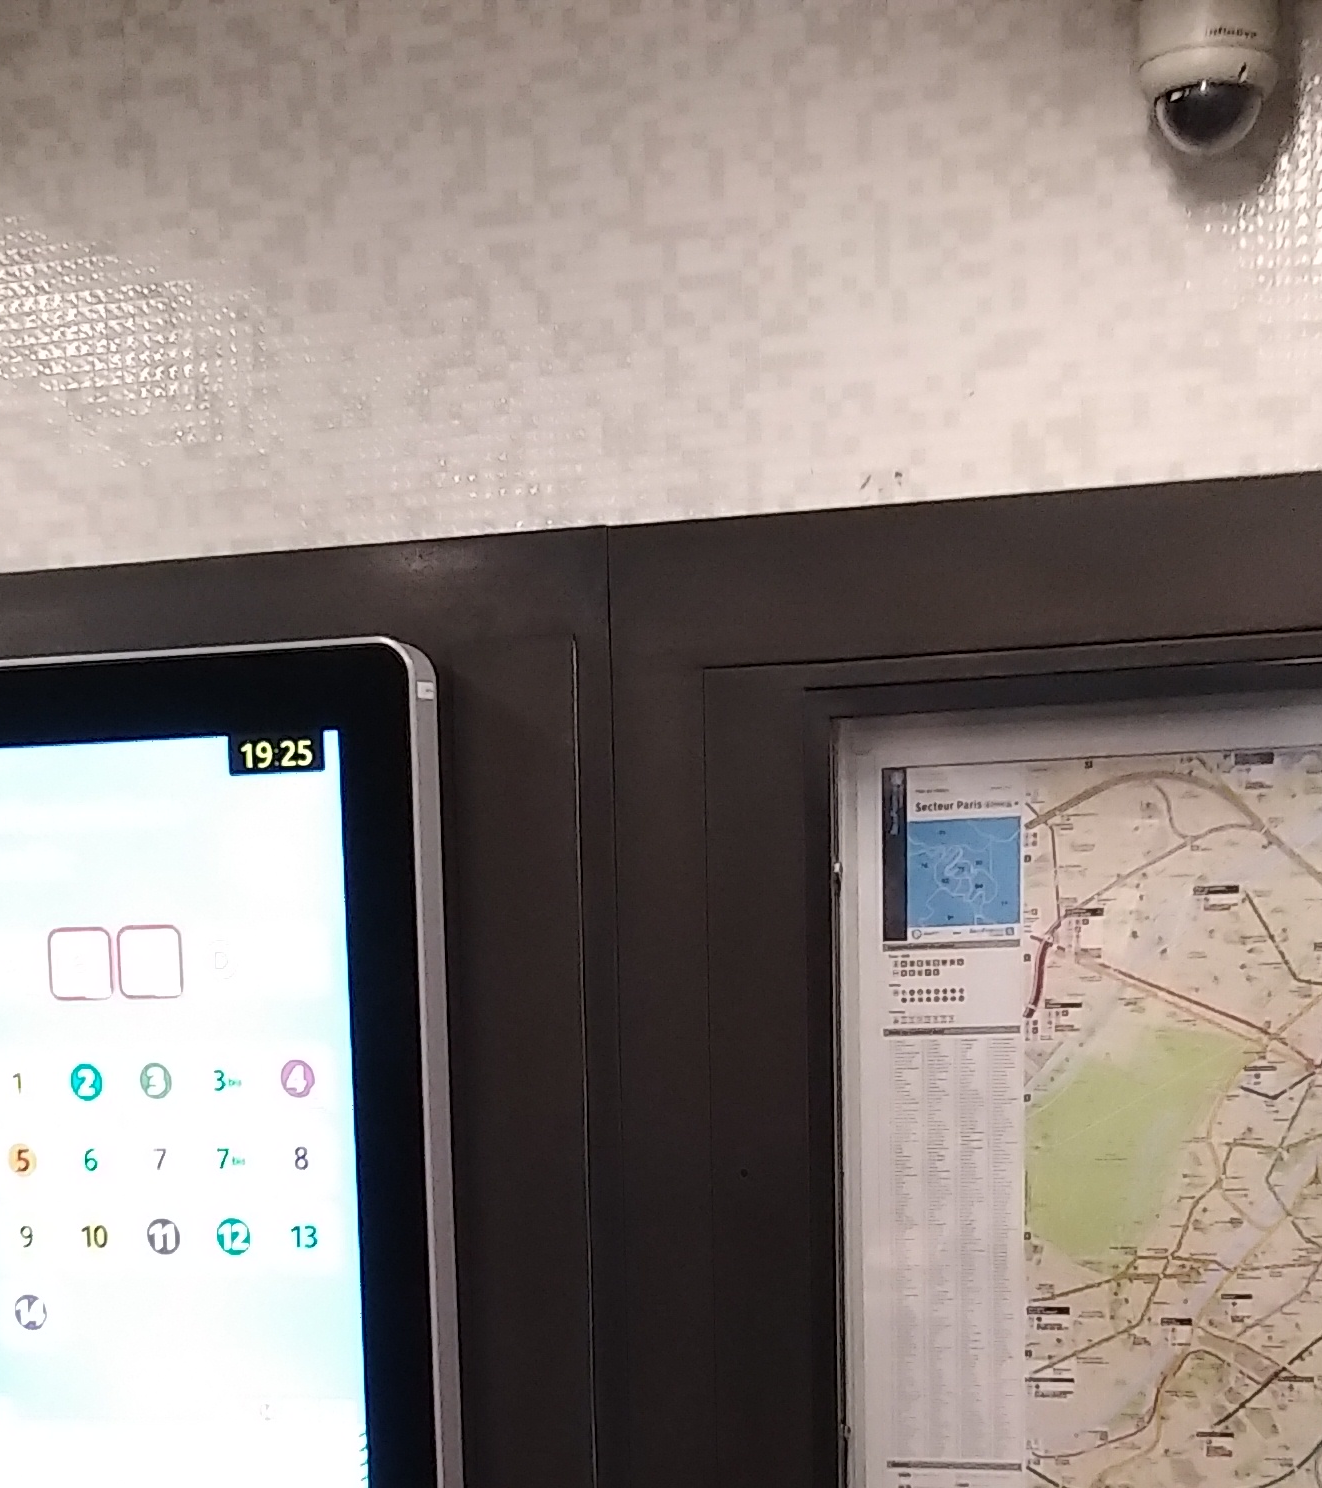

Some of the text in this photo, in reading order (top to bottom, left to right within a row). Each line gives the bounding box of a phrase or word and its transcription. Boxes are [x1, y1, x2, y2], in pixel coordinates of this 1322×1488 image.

[240, 739, 313, 769] 19:25
[915, 800, 954, 813] Secteur
[956, 799, 983, 810] Paris
[12, 1072, 22, 1094] 1
[77, 1068, 97, 1097] 2
[146, 1066, 167, 1097] 3
[285, 1064, 308, 1095] 4
[14, 1148, 31, 1173] 5
[84, 1148, 99, 1172] 6
[152, 1148, 167, 1171] 7
[294, 1146, 309, 1170] 8
[19, 1222, 319, 1251] 9 10 11 12 13
